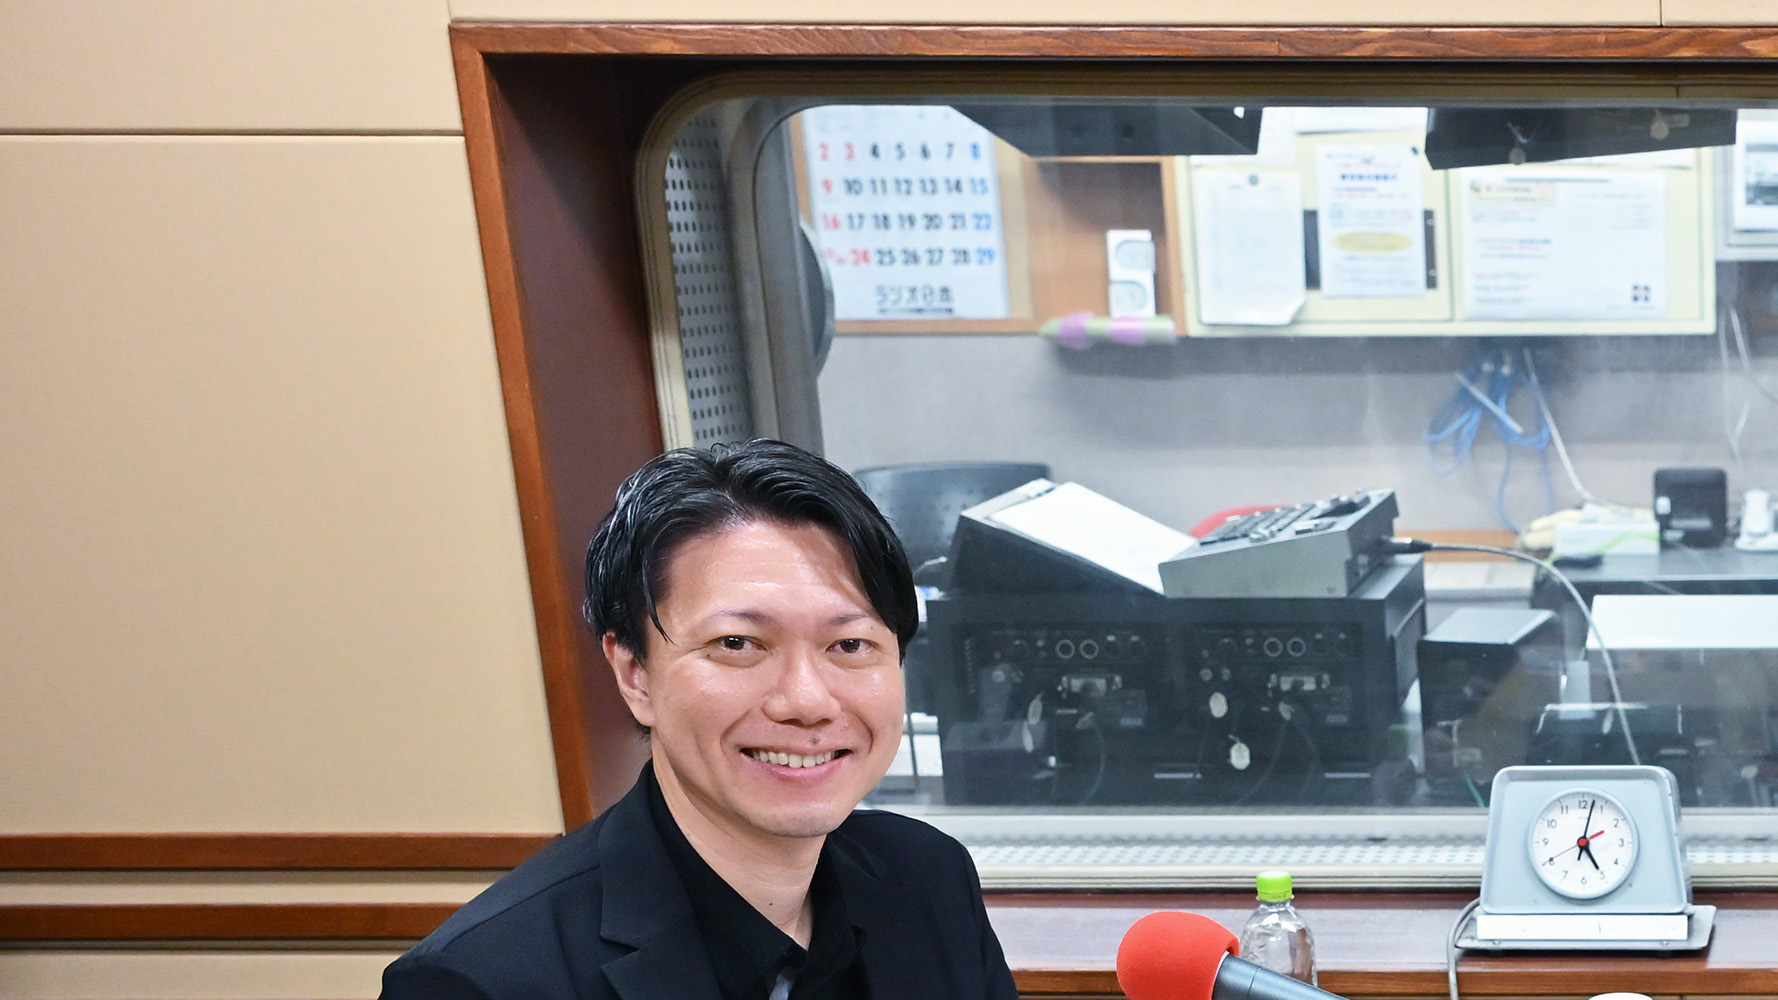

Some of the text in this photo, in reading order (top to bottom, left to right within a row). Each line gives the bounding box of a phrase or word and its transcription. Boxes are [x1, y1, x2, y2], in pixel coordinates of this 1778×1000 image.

[1578, 800, 1588, 809] 12
[1560, 805, 1568, 814] 11
[1547, 819, 1557, 828] 10
